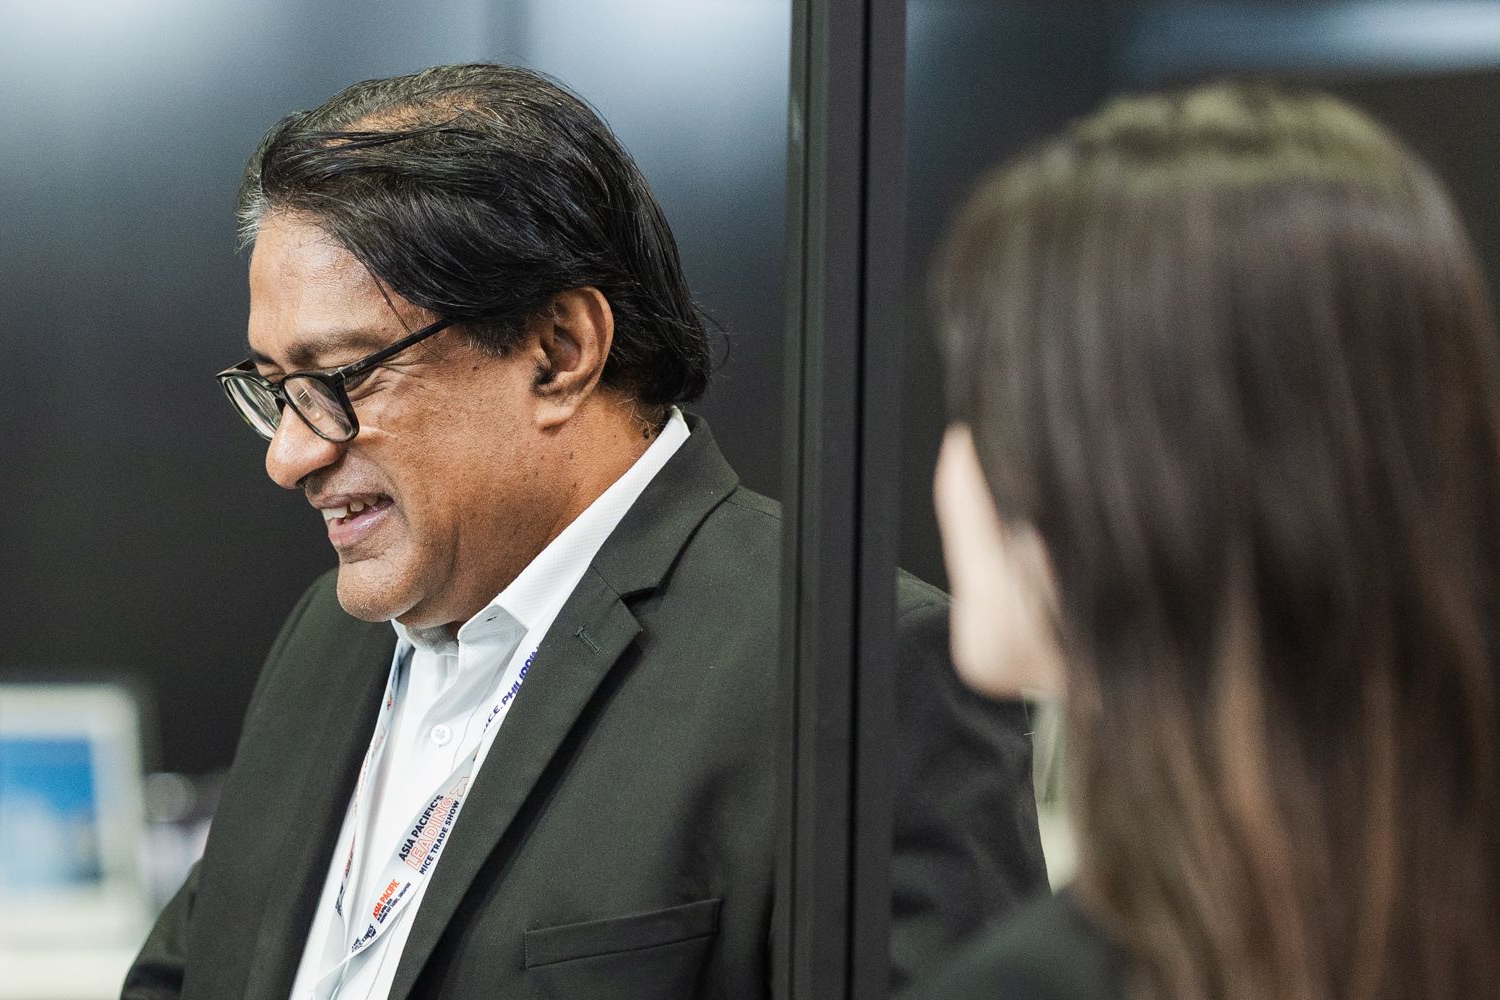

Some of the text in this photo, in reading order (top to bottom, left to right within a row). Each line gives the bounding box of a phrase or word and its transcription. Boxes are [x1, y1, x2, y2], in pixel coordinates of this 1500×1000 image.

[398, 794, 444, 861] ASIA PACIFIC'S
[406, 796, 454, 871] LEADING
[419, 799, 460, 875] MICE TRADE SHOW
[373, 902, 383, 920] ASIA
[380, 878, 400, 904] PACIFIC
